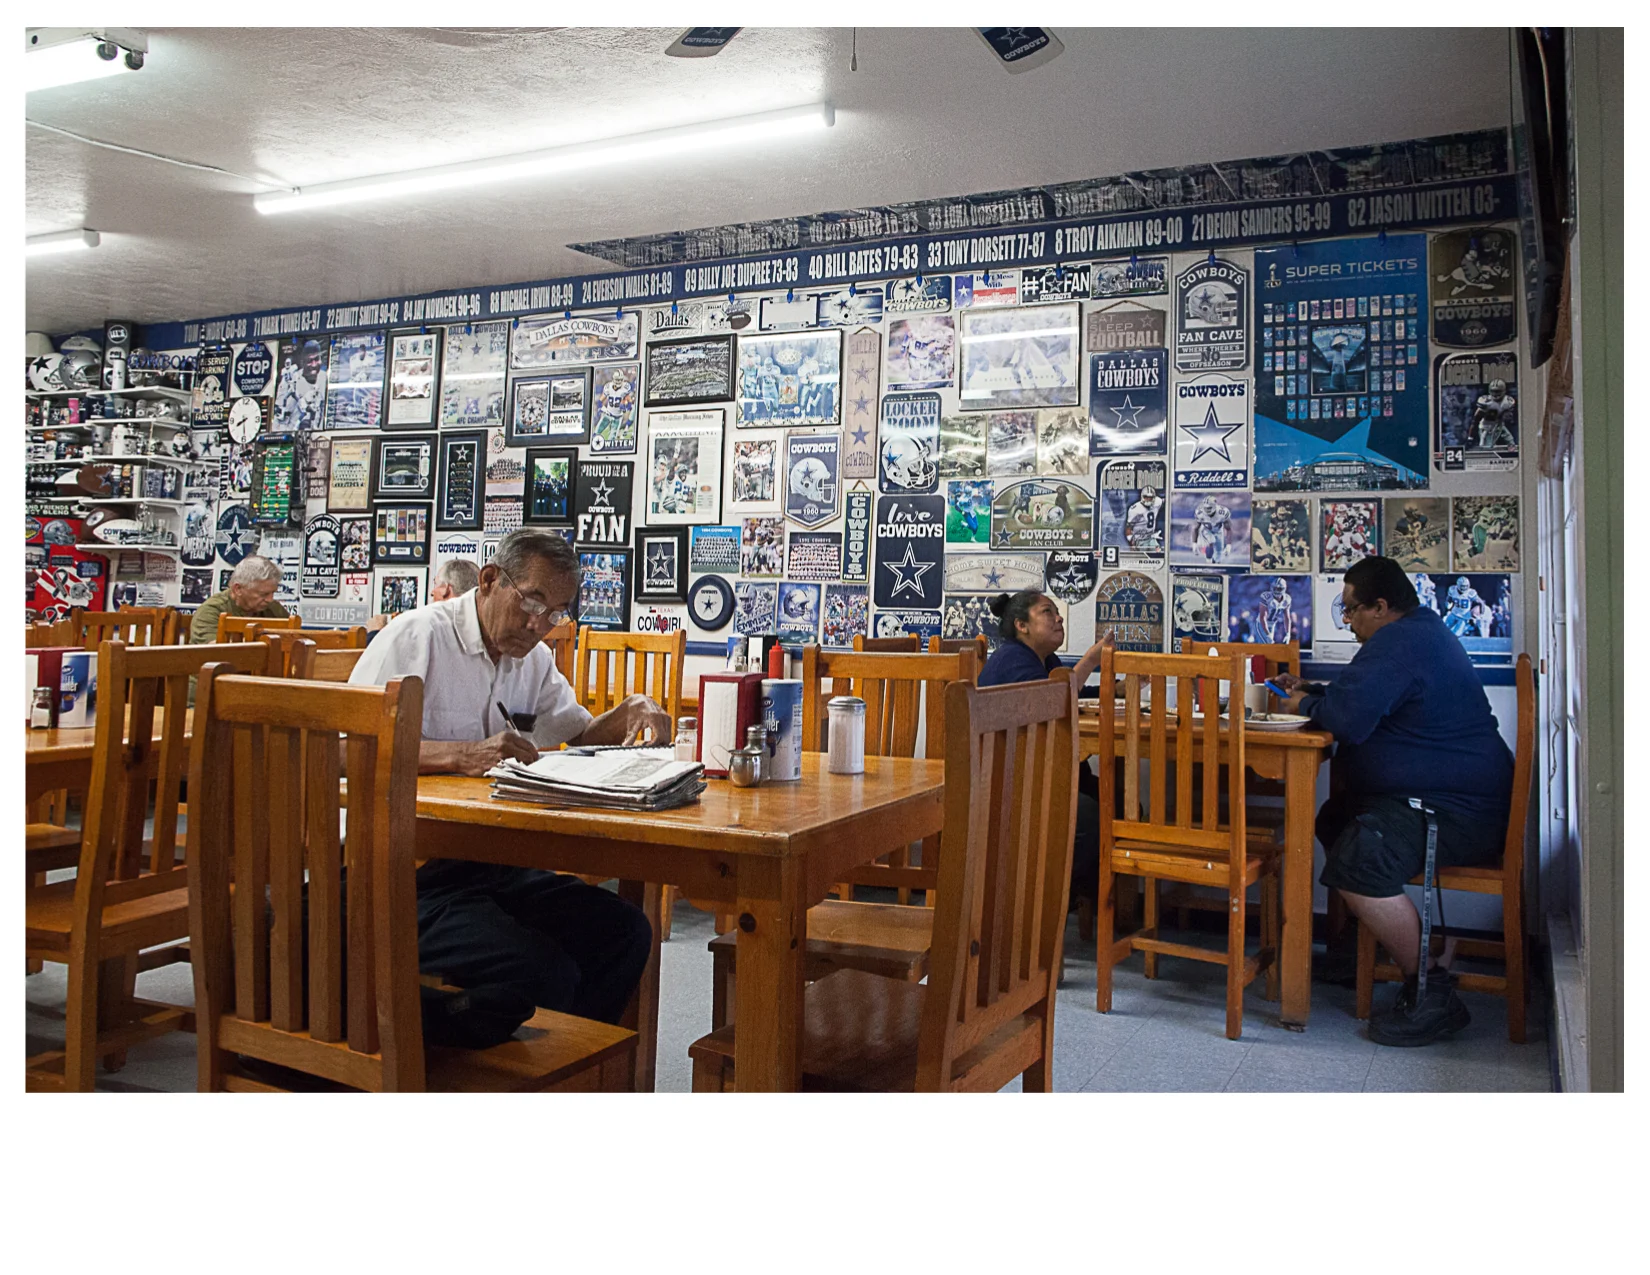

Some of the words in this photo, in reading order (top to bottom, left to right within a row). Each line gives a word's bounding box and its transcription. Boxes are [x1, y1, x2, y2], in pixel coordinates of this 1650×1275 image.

[684, 37, 725, 45] COWBOYS
[1003, 36, 1047, 60] COWBOYS
[1348, 198, 1366, 227] 82
[1368, 192, 1414, 225] JASON
[1416, 188, 1471, 221] WITTEN
[1473, 184, 1500, 215] 03-
[1191, 216, 1205, 242] 21
[1206, 211, 1240, 240] DEION
[1241, 206, 1293, 236] SANDERS
[1294, 202, 1331, 232] 95-99
[1055, 228, 1064, 252] 8
[1064, 225, 1095, 253] TROY
[1097, 221, 1144, 250] AIKMAN
[1145, 217, 1183, 245] 89-00
[927, 242, 942, 267] 33
[944, 239, 970, 266] TONY
[971, 233, 1017, 264] DORSETT
[1018, 231, 1045, 259] 77-87
[808, 255, 823, 280] 40
[825, 252, 847, 278] BILL
[849, 248, 882, 275] BATES
[884, 244, 919, 271] 79-83
[1285, 263, 1342, 278] SUPER
[1346, 257, 1419, 274] TICKETS
[684, 268, 696, 292] 89
[697, 265, 720, 291] BILLY
[720, 263, 736, 289] JOE
[737, 259, 771, 286] DUPREE
[771, 257, 799, 283] 73-83
[1179, 267, 1244, 290] COWBOYS
[582, 281, 592, 304] 24
[593, 279, 624, 302] EVERSON
[625, 274, 650, 299] WALLS
[651, 271, 673, 296] 81-89
[1022, 275, 1049, 297] #1
[1064, 272, 1090, 292] FAN
[490, 292, 500, 314] 88
[501, 288, 530, 312] MICHAEL
[530, 286, 550, 309] IRVIN
[551, 283, 574, 306] 88-99
[887, 298, 949, 312] COWBOYS
[1446, 297, 1501, 305] DALLAS
[326, 309, 335, 328] 22
[335, 307, 359, 328] EMMITT
[359, 304, 379, 326] SMITH
[379, 302, 399, 324] 90-02
[404, 301, 413, 321] 84
[413, 299, 426, 321] JAY
[426, 296, 458, 319] NOVACEK
[458, 294, 481, 316] 90-96
[1434, 304, 1512, 321] COWBOYS
[253, 318, 261, 336] 71
[261, 315, 279, 335] MARK
[301, 310, 321, 331] 83-97
[656, 309, 689, 328] Dallas
[1089, 314, 1116, 323] EAT
[1089, 322, 1134, 332] SLEEP
[225, 319, 247, 338] 60-88
[535, 323, 569, 338] DALLAS
[570, 320, 616, 335] COWBOYS
[1179, 331, 1205, 343] FAN
[1209, 329, 1243, 342] CAVE
[1089, 330, 1161, 350] FOOTBALL
[1098, 358, 1159, 370] DALLAS
[1201, 351, 1221, 362] NO
[201, 366, 226, 374] PARKING
[237, 360, 270, 376] STOP
[1097, 367, 1159, 388] COWBOYS
[1179, 383, 1245, 398] COWBOYS
[886, 401, 937, 416] LOCKER
[604, 439, 634, 448] WITTEN
[790, 443, 837, 454] COWBOYS
[845, 454, 874, 468] COWBOYS
[1446, 450, 1463, 462] 24
[219, 455, 229, 500] DALLAS
[580, 464, 611, 477] PROUD
[1187, 470, 1234, 484] Riddell
[887, 503, 934, 524] love
[305, 519, 341, 536] COWBOYS
[576, 514, 626, 542] FAN
[847, 497, 869, 574] COWBOYS
[878, 524, 943, 538] COWBOYS
[1019, 529, 1074, 540] COWBOYS
[438, 543, 477, 553] COWBOYS
[1105, 547, 1116, 561] 9
[304, 567, 318, 575] FAN
[319, 567, 338, 575] CAVE
[948, 559, 975, 573] HOME
[977, 558, 1012, 567] SWEET
[1013, 559, 1041, 573] HOME
[1100, 576, 1157, 600] FIRST
[314, 607, 356, 621] COWBOYS
[903, 615, 941, 625] COWBOYS
[1099, 603, 1159, 622] DALLAS
[780, 622, 814, 632] COWBOYS
